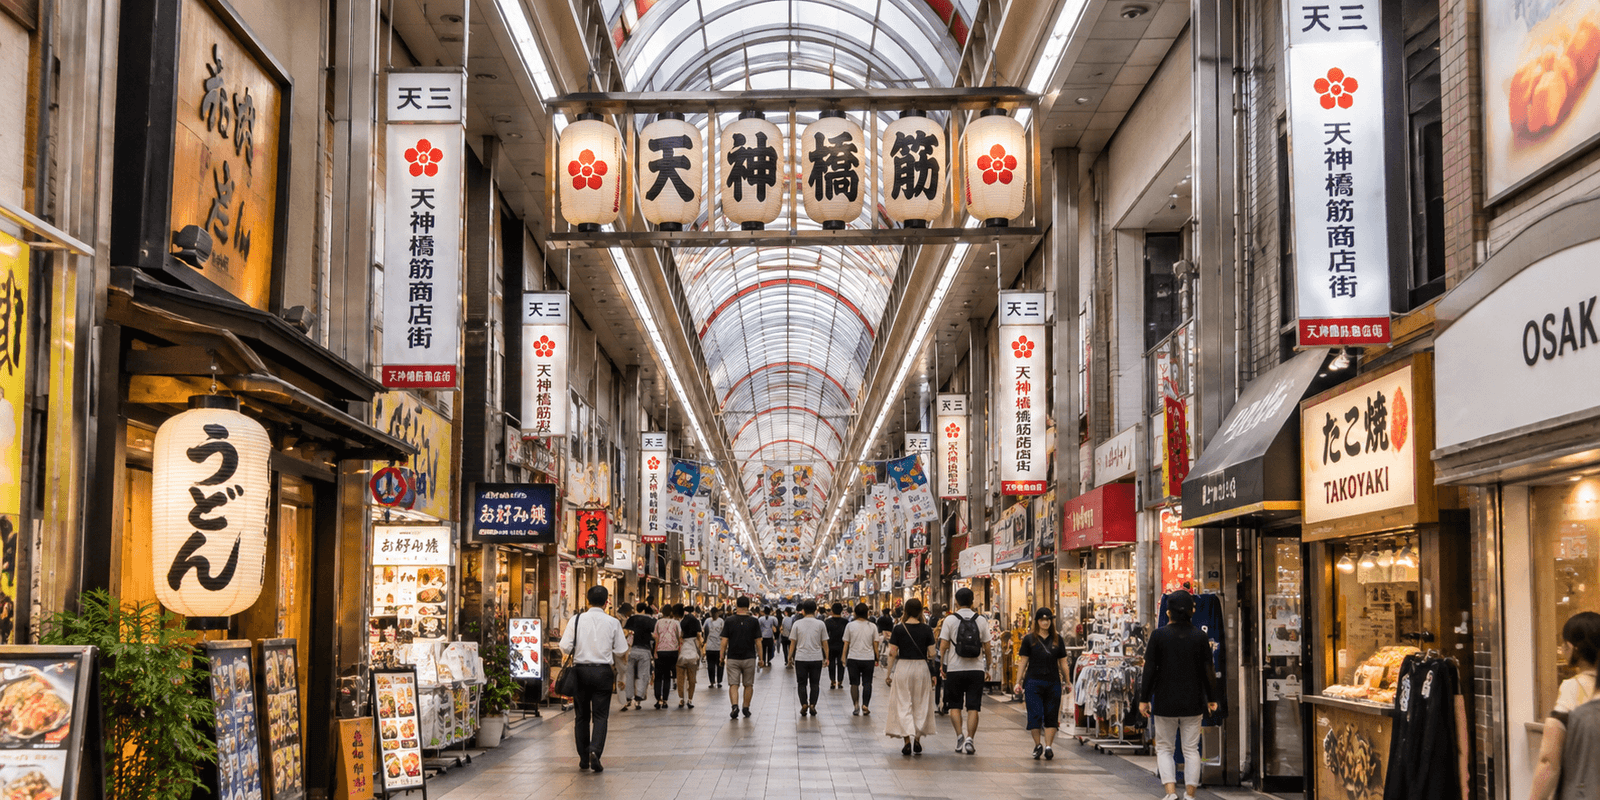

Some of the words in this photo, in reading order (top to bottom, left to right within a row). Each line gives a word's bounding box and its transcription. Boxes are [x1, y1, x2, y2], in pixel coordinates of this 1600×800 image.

[1302, 4, 1368, 32] 天三
[397, 87, 452, 110] 天三
[645, 130, 940, 203] 天神橋筋
[1323, 122, 1358, 298] 天神橋筋商店街
[407, 188, 436, 349] 天神橋筋商店街
[528, 302, 561, 317] 天三
[1007, 301, 1039, 317] 天三
[1322, 390, 1390, 466] たこ焼
[167, 423, 245, 592] うどん
[1323, 465, 1389, 504] TAKOYAKI
